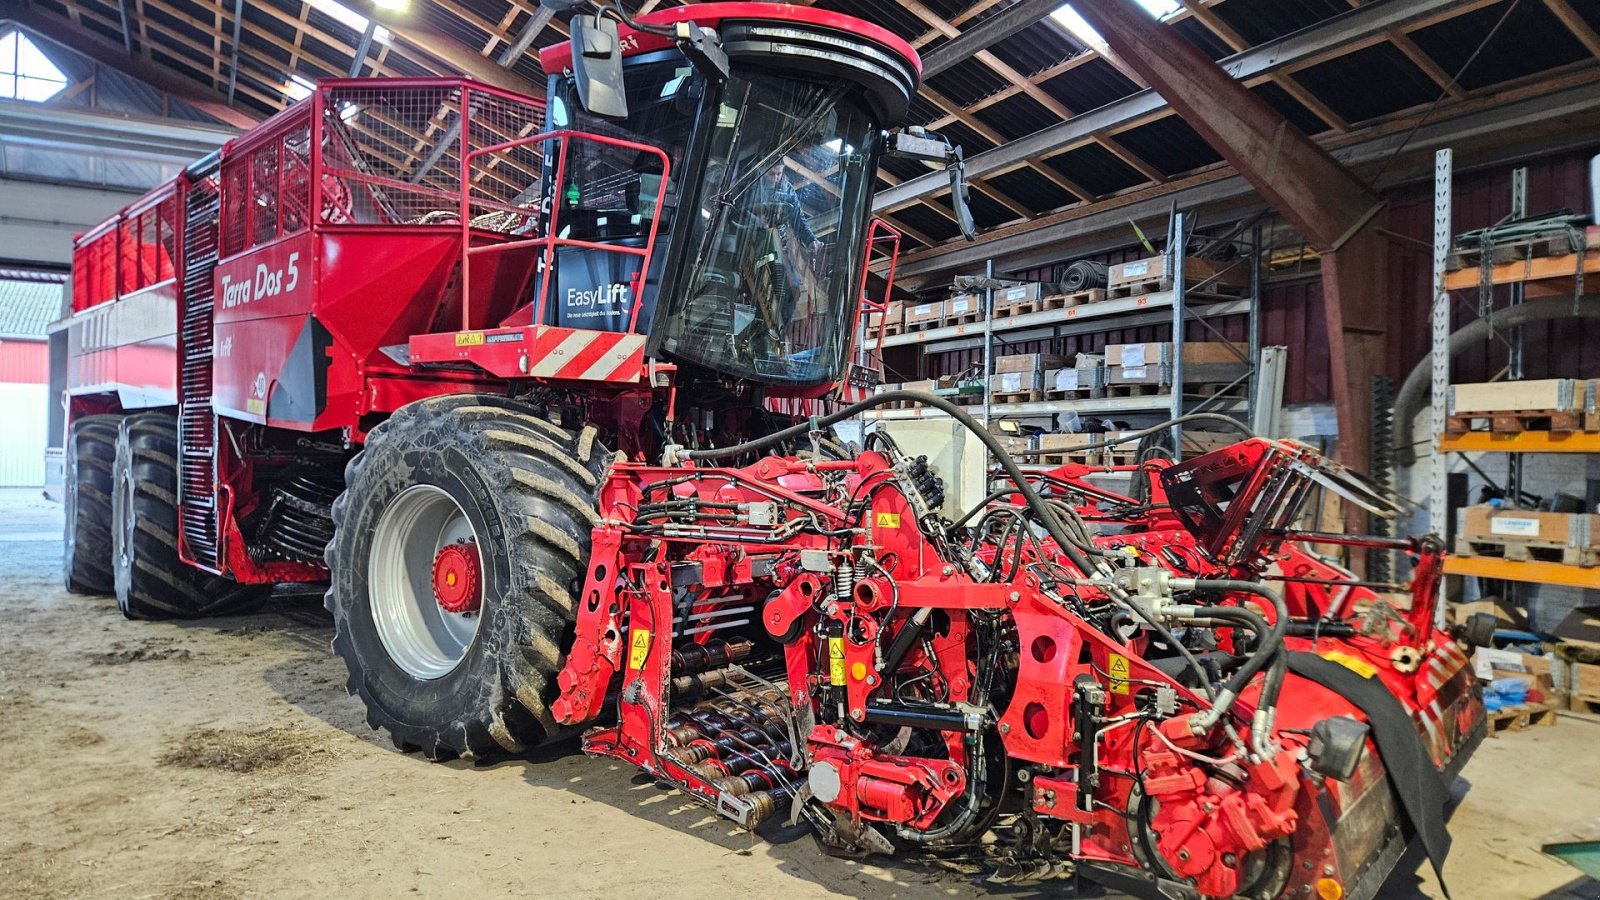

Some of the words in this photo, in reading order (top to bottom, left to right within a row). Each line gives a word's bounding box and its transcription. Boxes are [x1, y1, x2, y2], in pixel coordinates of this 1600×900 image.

[221, 274, 252, 310] Terra
[253, 263, 283, 301] Dos
[286, 252, 299, 292] 5
[567, 284, 628, 309] EasyLift
